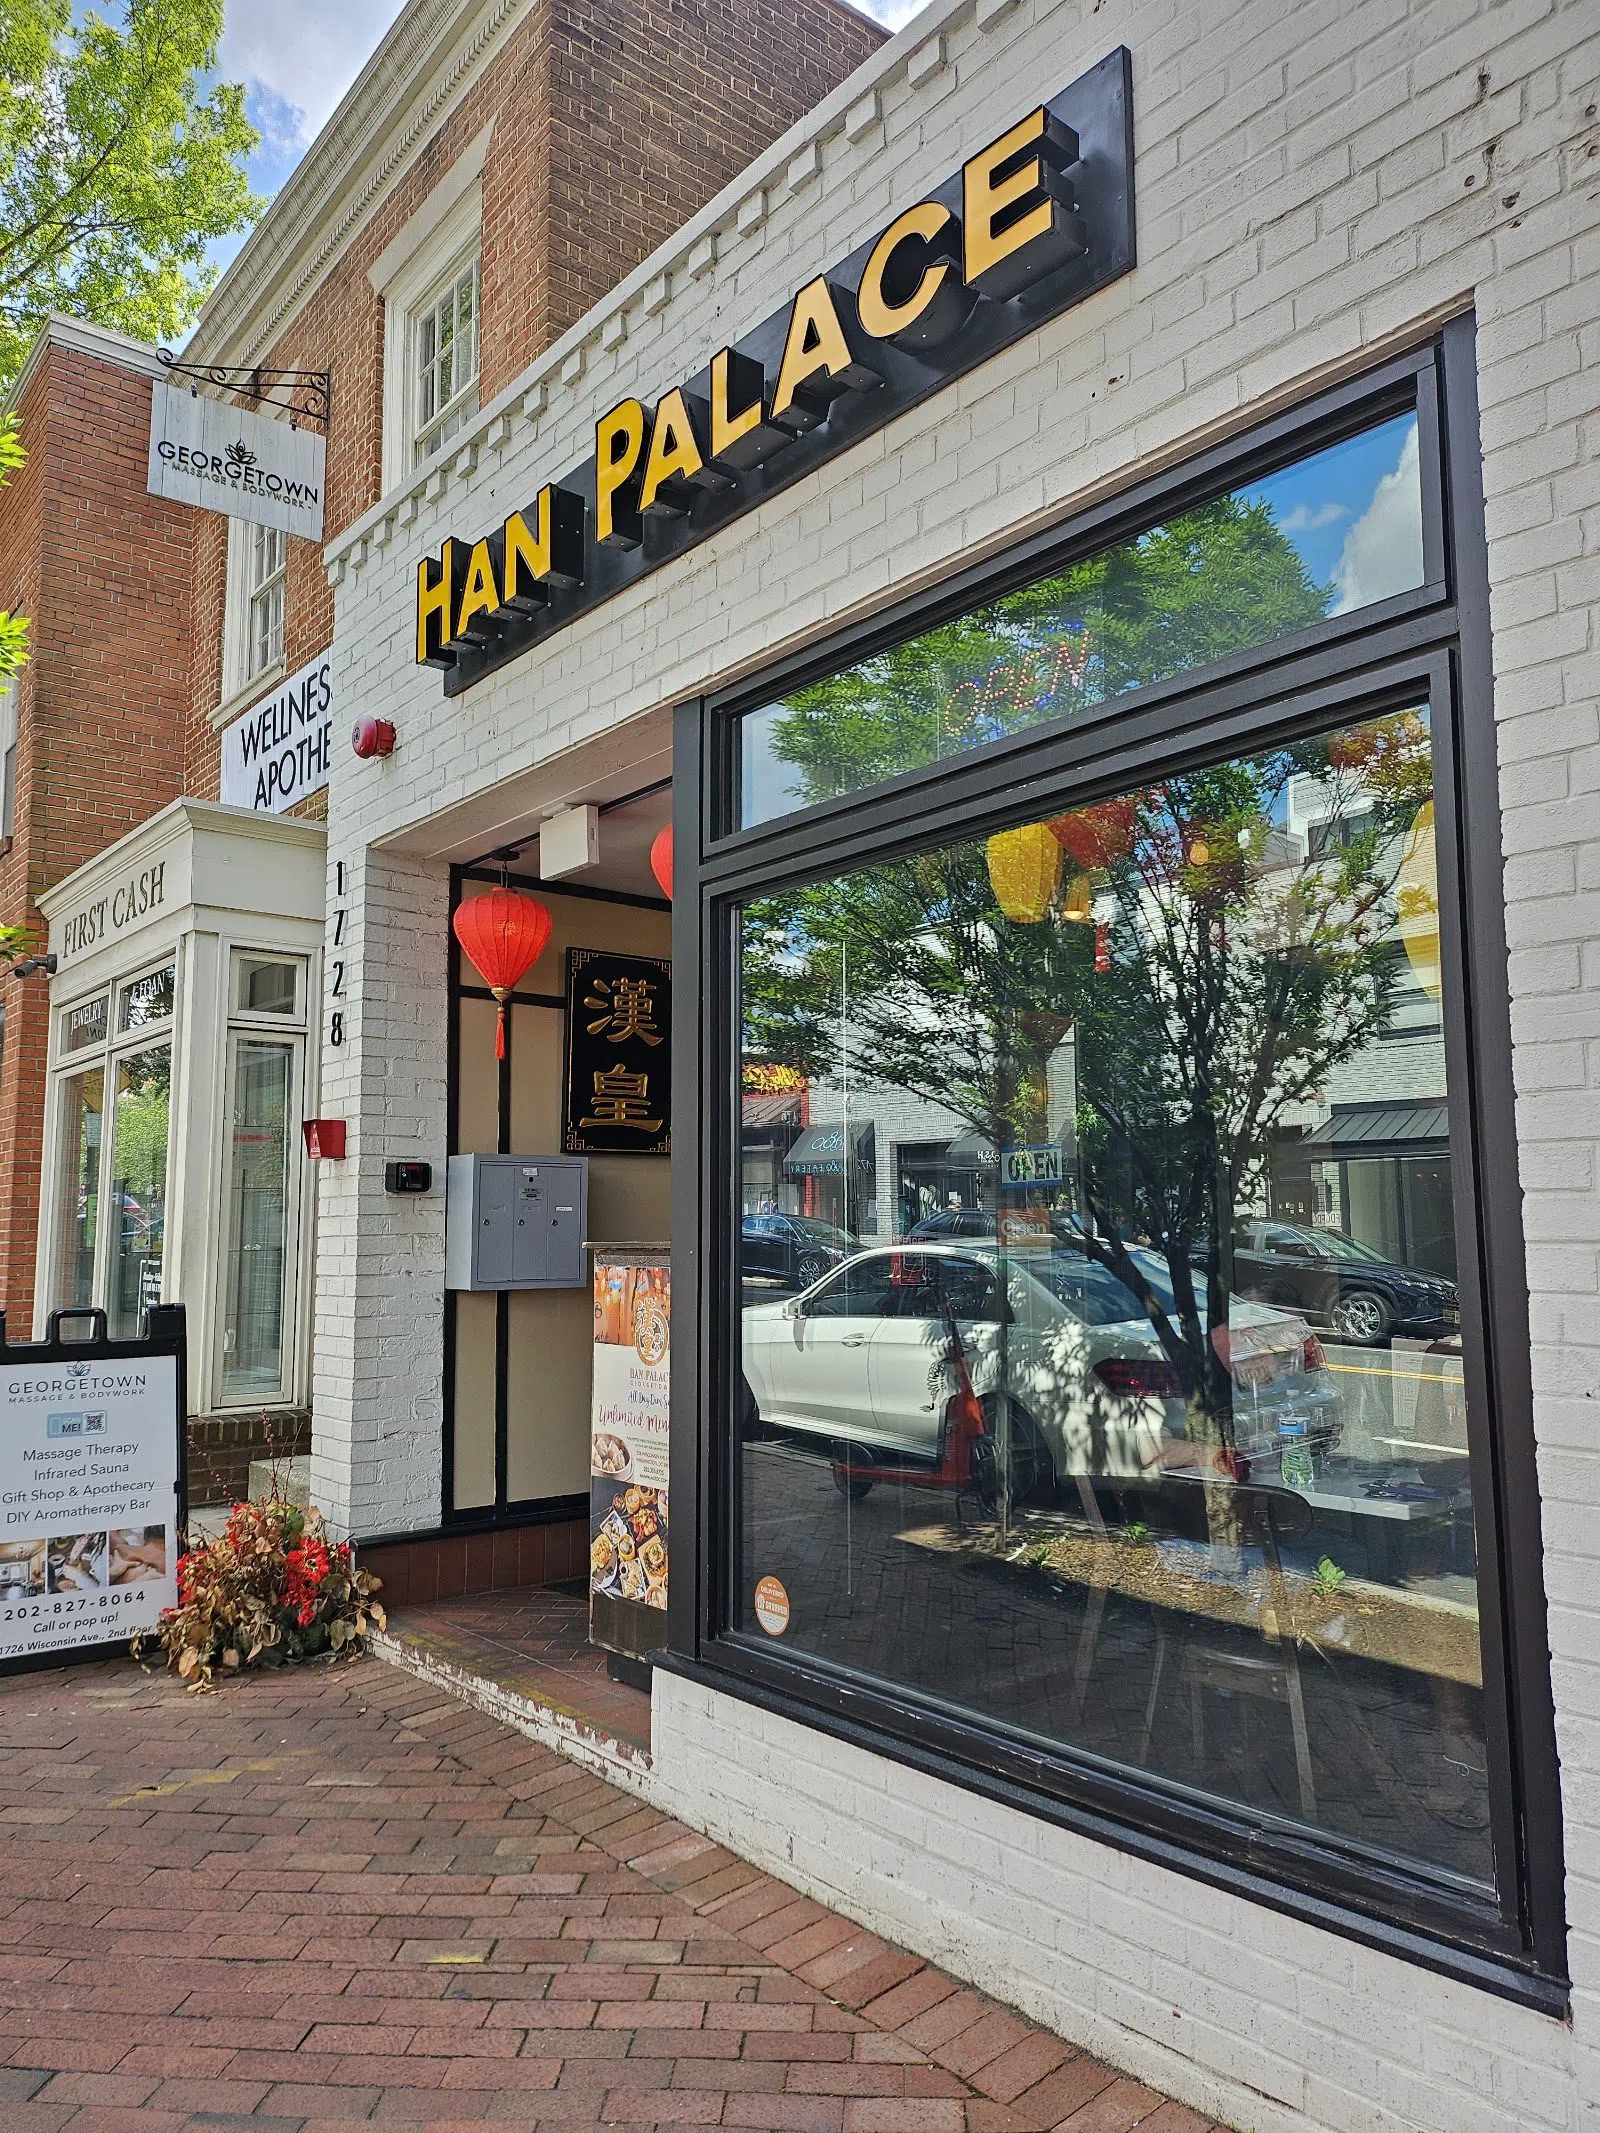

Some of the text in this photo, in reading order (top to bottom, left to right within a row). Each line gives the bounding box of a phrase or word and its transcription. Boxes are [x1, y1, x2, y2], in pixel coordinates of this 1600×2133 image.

[416, 105, 1055, 665] HAN PALACE
[157, 440, 318, 504] GEORGETOWN
[171, 462, 304, 509] MASSAGE & BODYWORK
[945, 629, 1090, 735] OPEN
[240, 663, 332, 768] WELLNES
[254, 720, 332, 810] APOTHE
[62, 860, 166, 959] FIRST CASH
[330, 860, 348, 1047] 1728
[71, 999, 103, 1034] JEWELRY
[579, 976, 664, 1134] 漢皇
[8, 1374, 147, 1395] GEORGETOWN
[8, 1393, 64, 1405] MASSAGE
[80, 1388, 145, 1400] BODYWORK
[62, 1423, 81, 1433] ME!
[646, 1414, 670, 1433] Men
[23, 1442, 139, 1462] Massage Therapy
[34, 1462, 130, 1481] Infrared Sauna
[2, 1480, 156, 1505] Gift Shop & Apothecary
[6, 1498, 151, 1525] DIY Aromatherapy Bar
[4, 1590, 146, 1622] 202-827-8064
[27, 1636, 77, 1651] Wisconsin
[107, 1626, 127, 1639] 2nd
[33, 1611, 119, 1634] Call or pop up!
